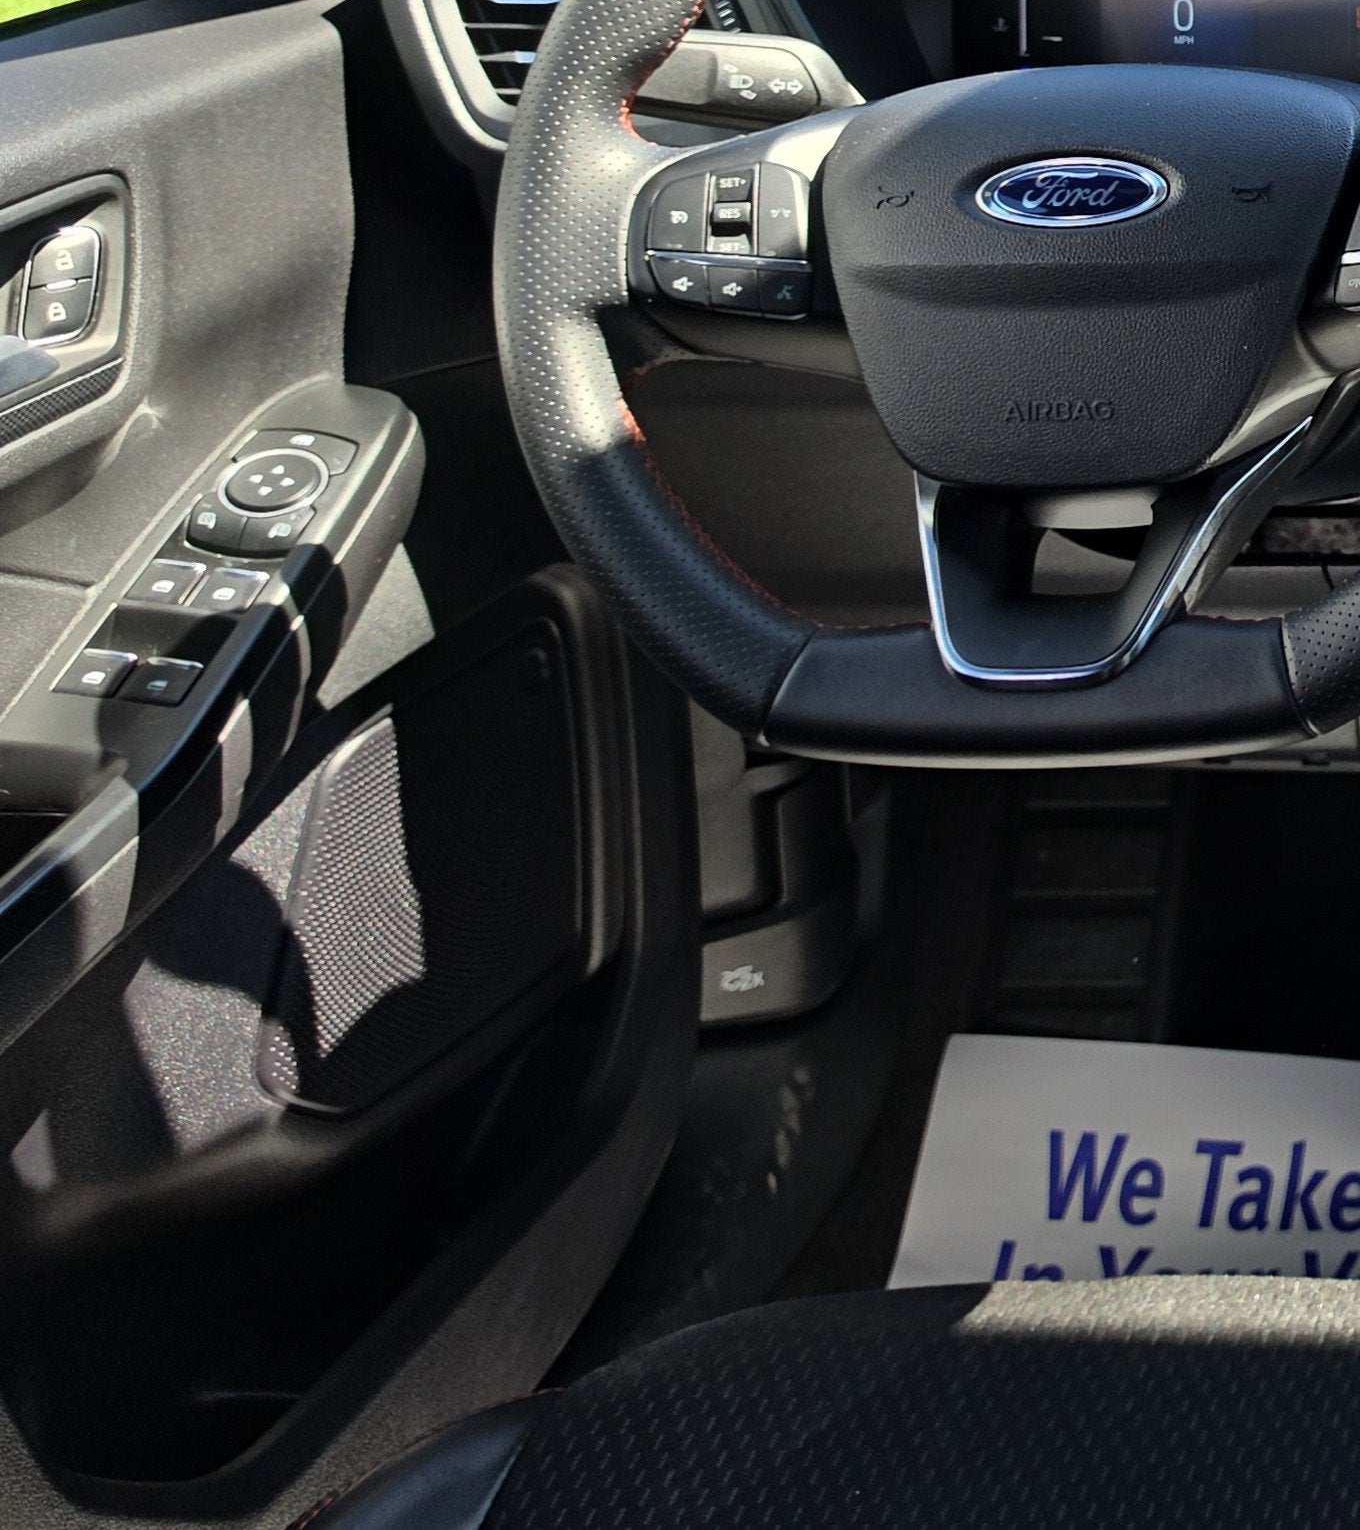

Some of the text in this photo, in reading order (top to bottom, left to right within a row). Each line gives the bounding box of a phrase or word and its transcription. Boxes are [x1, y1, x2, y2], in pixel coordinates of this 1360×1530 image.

[1174, 35, 1195, 46] MPH
[1021, 170, 1121, 209] Ford
[718, 208, 741, 219] RES
[1005, 398, 1114, 422] AIRBAG
[1045, 1128, 1165, 1227] We
